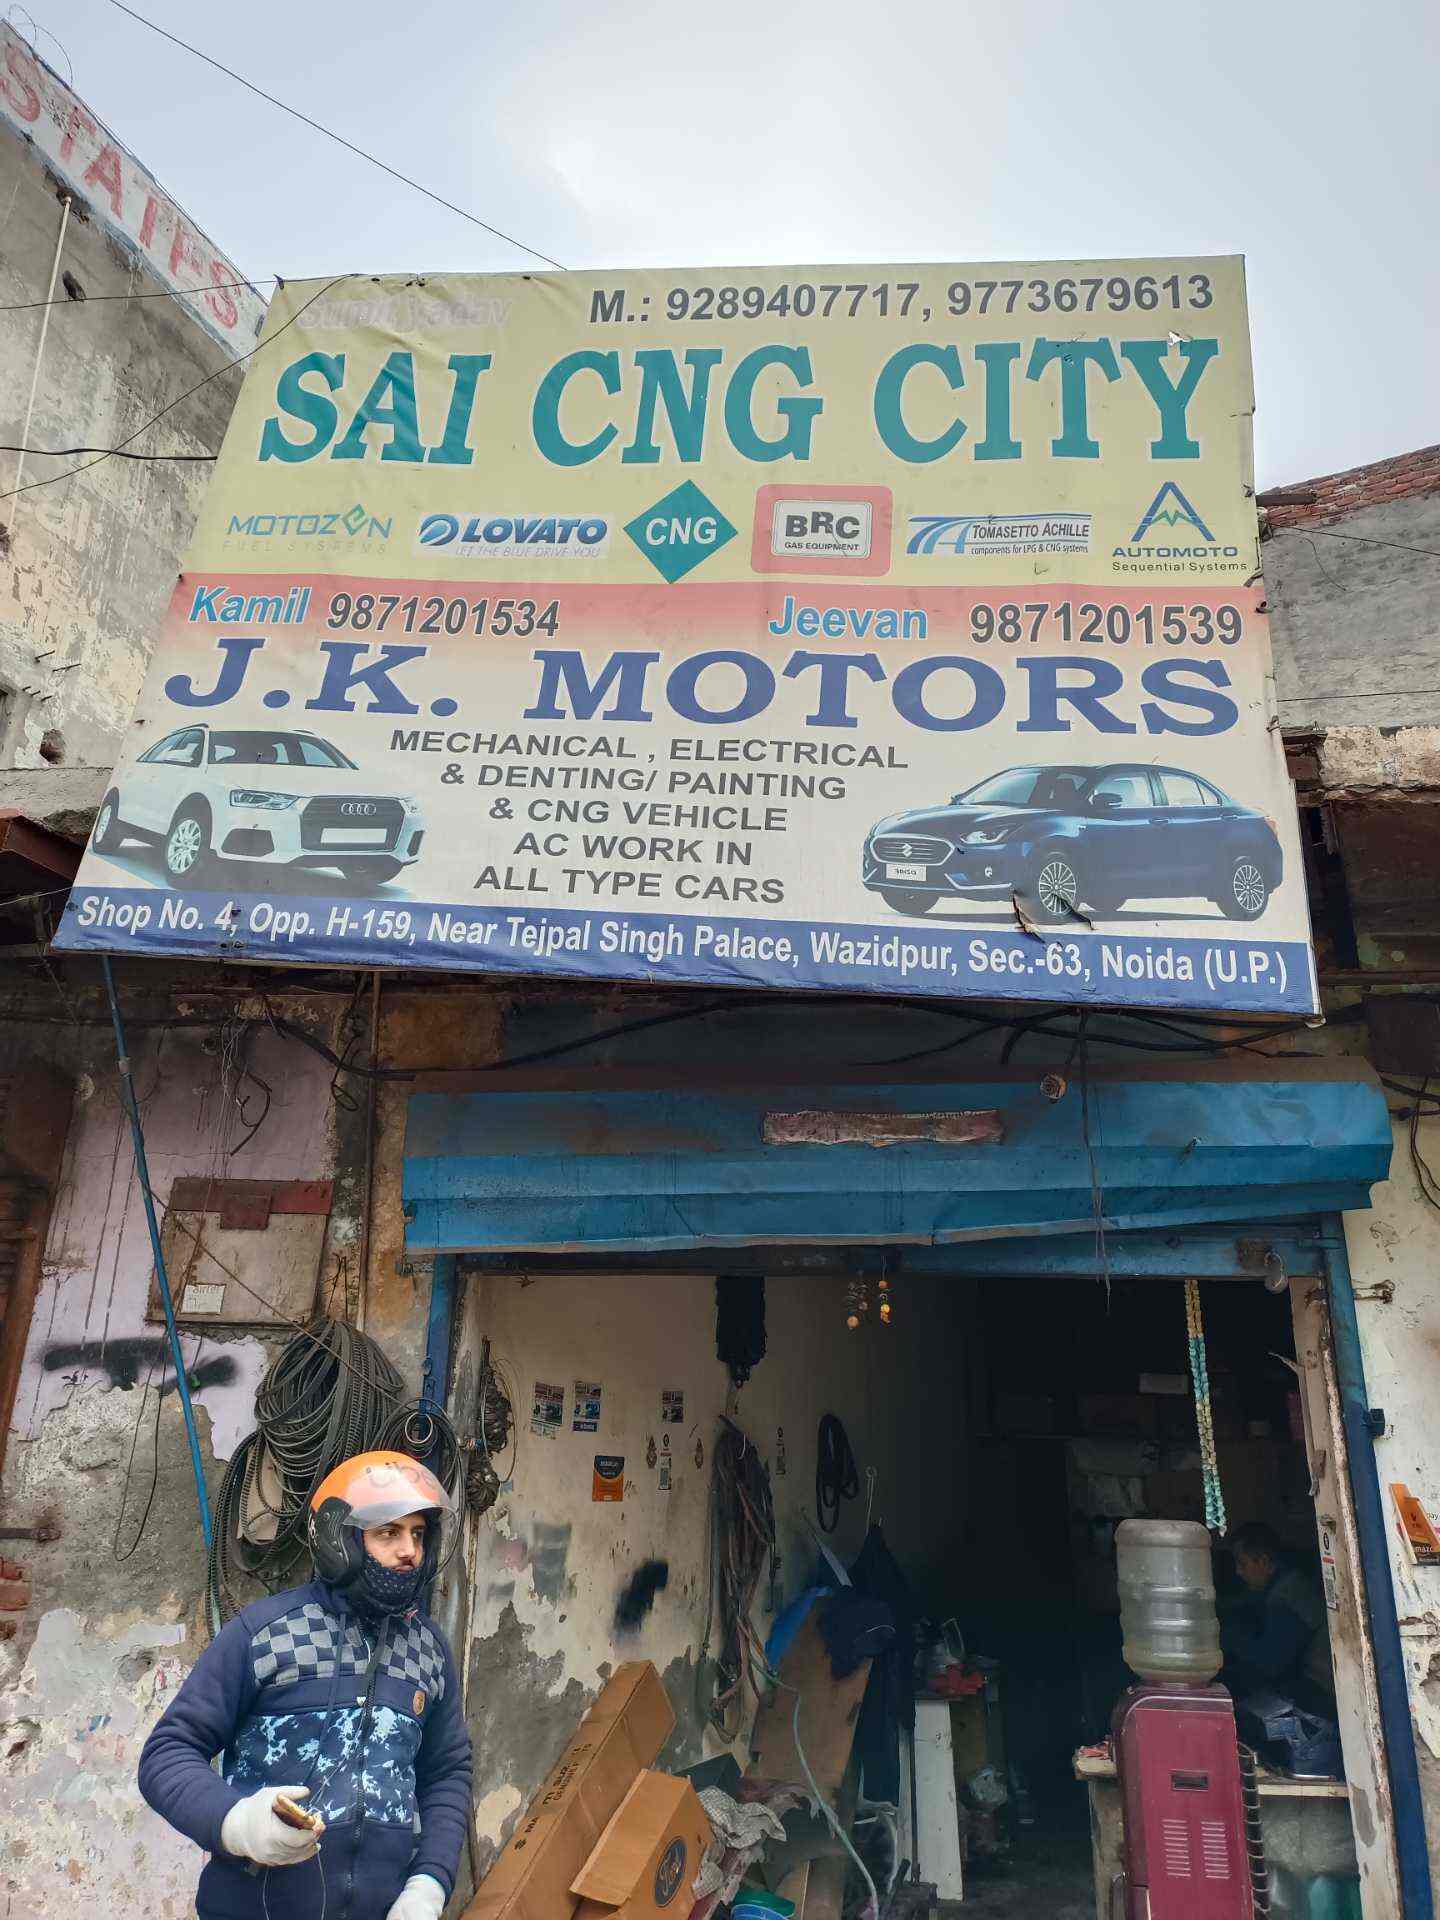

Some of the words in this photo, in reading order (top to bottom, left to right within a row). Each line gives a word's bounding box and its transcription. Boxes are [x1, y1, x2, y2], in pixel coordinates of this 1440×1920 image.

[590, 289, 650, 323] M.:
[667, 283, 933, 323] 9289407717,
[947, 275, 1213, 316] 9773679613
[258, 350, 493, 465] SAI
[530, 343, 824, 466] CNG
[873, 336, 1219, 464] CITY
[461, 518, 608, 545] LOVATO
[645, 517, 718, 546] CNG
[785, 511, 860, 539] BRC
[972, 524, 1039, 539] TOMASETTO
[1042, 522, 1090, 537] ACHILLE
[806, 542, 860, 551] EQUIPMENT
[971, 544, 1011, 556] components
[1012, 544, 1022, 554] for
[1023, 544, 1037, 554] LPG
[1045, 542, 1061, 552] CNG
[1062, 543, 1089, 554] systems
[1112, 546, 1238, 557] AUTOMOTO
[1112, 561, 1185, 573] Sequential
[1188, 562, 1248, 573] Systems
[189, 586, 312, 625] Kamil
[326, 593, 560, 637] 9871201534
[769, 597, 926, 640] Jeevan
[970, 603, 1243, 645] 9871201539
[164, 638, 458, 717] J.K.
[523, 650, 1240, 737] MOTORS
[669, 738, 909, 769] ELECTRICAL
[440, 763, 465, 784] &
[477, 764, 657, 792] DENTING/
[668, 771, 847, 800] PAINTING
[489, 798, 514, 819] &
[527, 799, 609, 825] CNG
[623, 803, 788, 831] VEHICLE
[513, 833, 568, 856] AC
[582, 835, 702, 864] WORK
[716, 840, 752, 866] IN
[473, 866, 549, 892] ALL
[562, 868, 662, 898] TYPE
[674, 873, 785, 904] CARS
[78, 896, 151, 935] Shop
[158, 899, 204, 930] No.
[214, 901, 238, 936] 4,
[249, 903, 315, 942] Opp.
[326, 907, 416, 945] H-159,
[427, 912, 497, 945] Near
[506, 917, 591, 957] Tejpal
[600, 920, 683, 963] Singh
[693, 925, 799, 968] Palace,
[810, 931, 958, 976] Wazidpur,
[1103, 945, 1193, 982] Noida
[1204, 949, 1287, 994] (U.P.)
